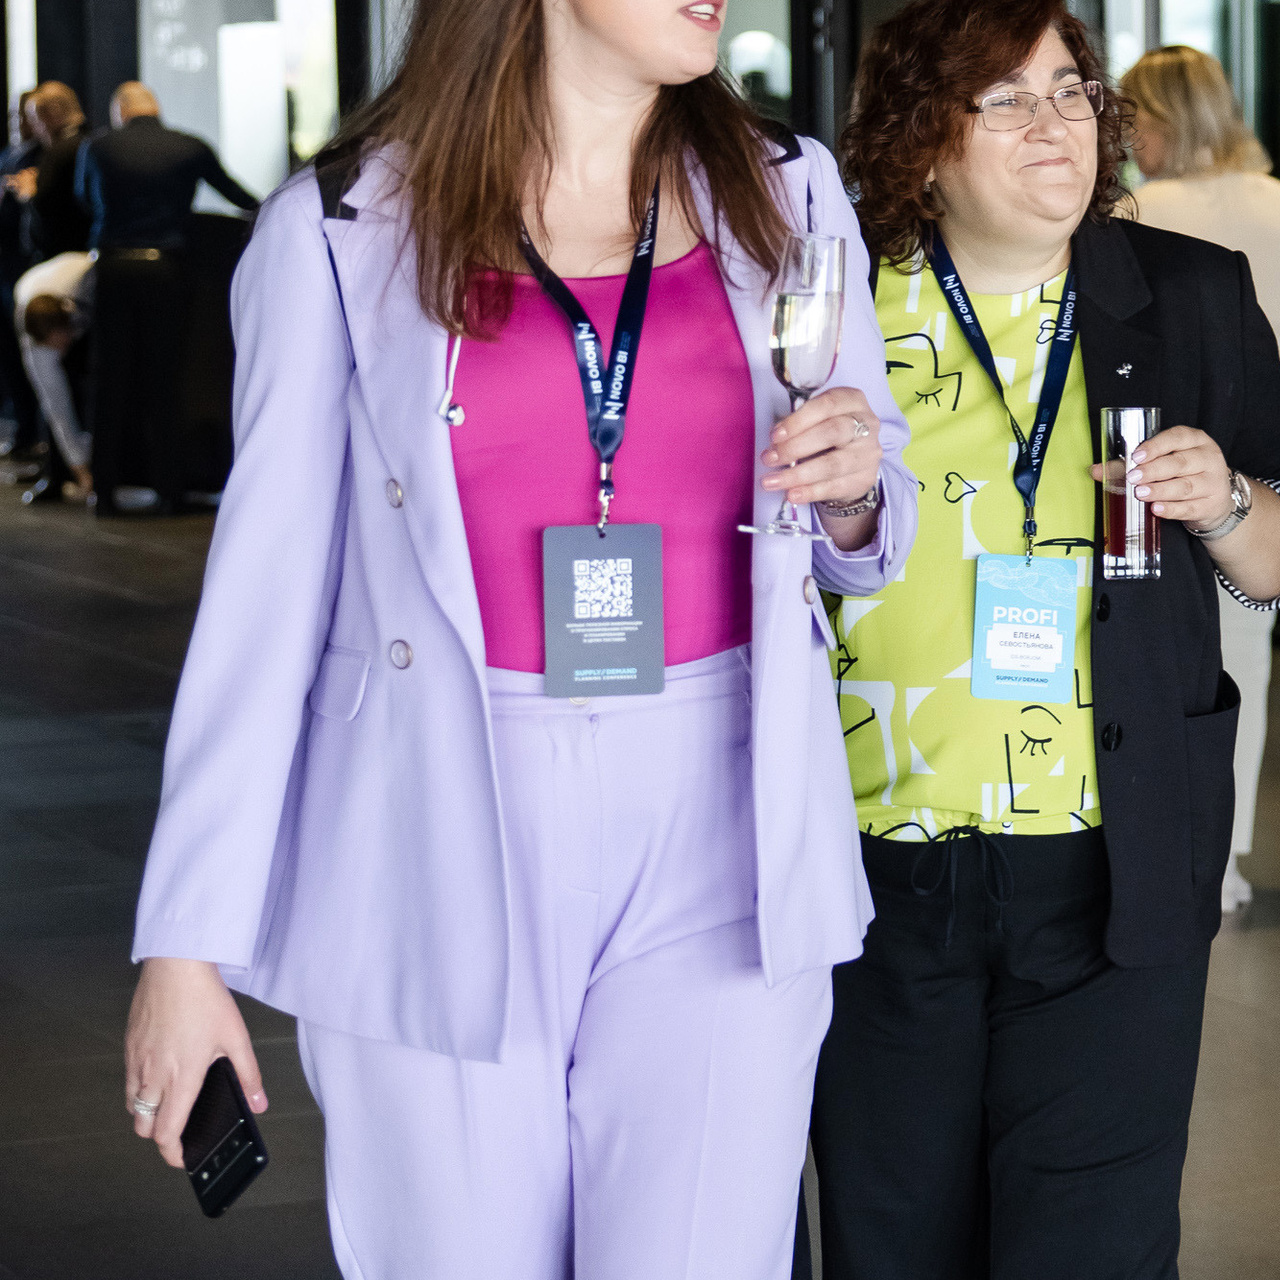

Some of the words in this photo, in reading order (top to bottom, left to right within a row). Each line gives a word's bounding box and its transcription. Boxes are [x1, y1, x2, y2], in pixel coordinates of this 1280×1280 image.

[1068, 291, 1077, 301] BI
[952, 288, 969, 314] NOVO
[963, 314, 974, 324] BI
[1062, 301, 1075, 328] NOVO
[584, 340, 600, 379] NOVO
[616, 350, 628, 364] BI
[591, 380, 603, 394] BI
[610, 364, 626, 400] NOVO
[993, 606, 1058, 626] PROFI
[1013, 631, 1041, 640] ЕЛЕНА
[999, 640, 1054, 650] СЕВОСТЬЯНОВА
